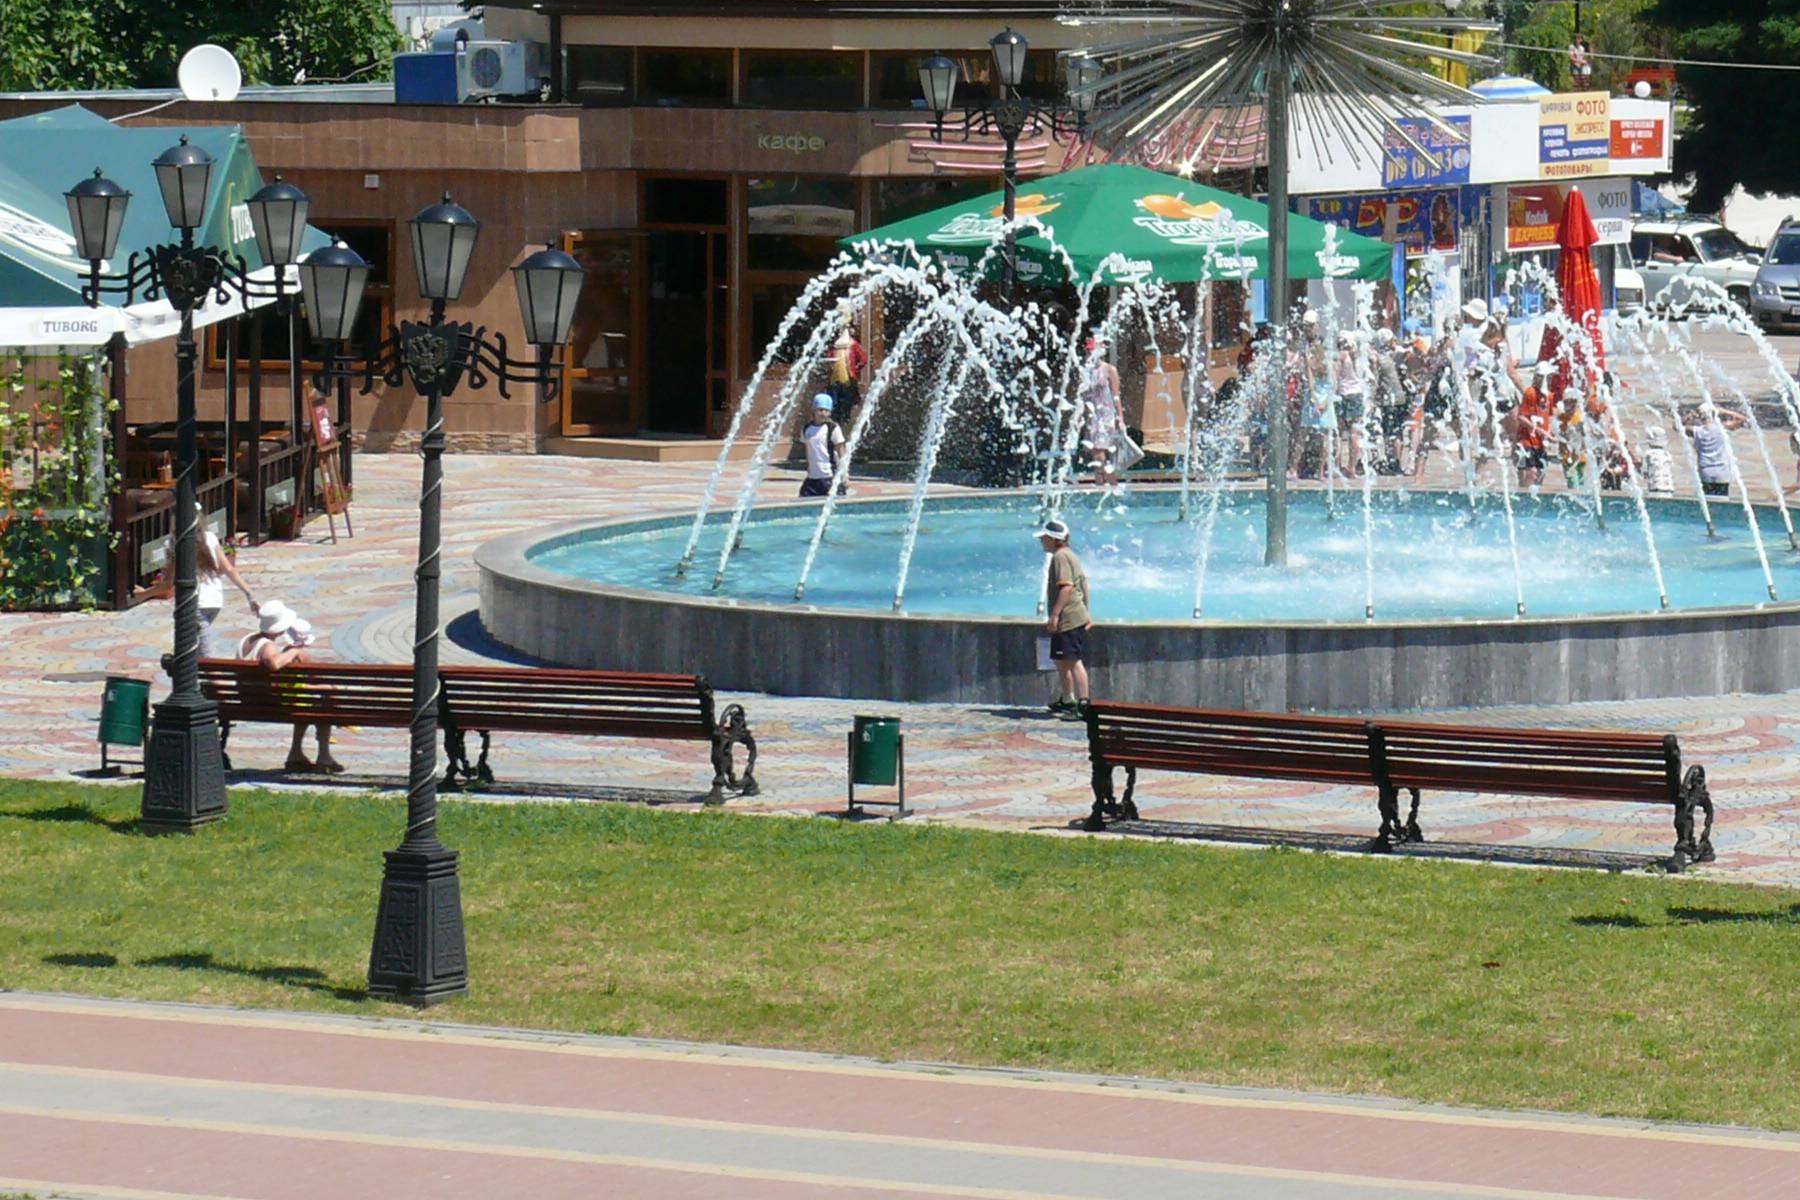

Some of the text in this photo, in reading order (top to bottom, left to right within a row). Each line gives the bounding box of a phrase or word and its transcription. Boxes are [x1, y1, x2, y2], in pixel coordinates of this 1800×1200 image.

[1576, 99, 1606, 116] ФОТО
[758, 132, 825, 155] кафе
[1545, 163, 1593, 176] ФОТОТОВАРЫ
[1598, 191, 1628, 208] ФОТО
[1525, 208, 1549, 225] Kodak
[1515, 225, 1555, 242] EXPRESS
[43, 320, 98, 333] TUBORG
